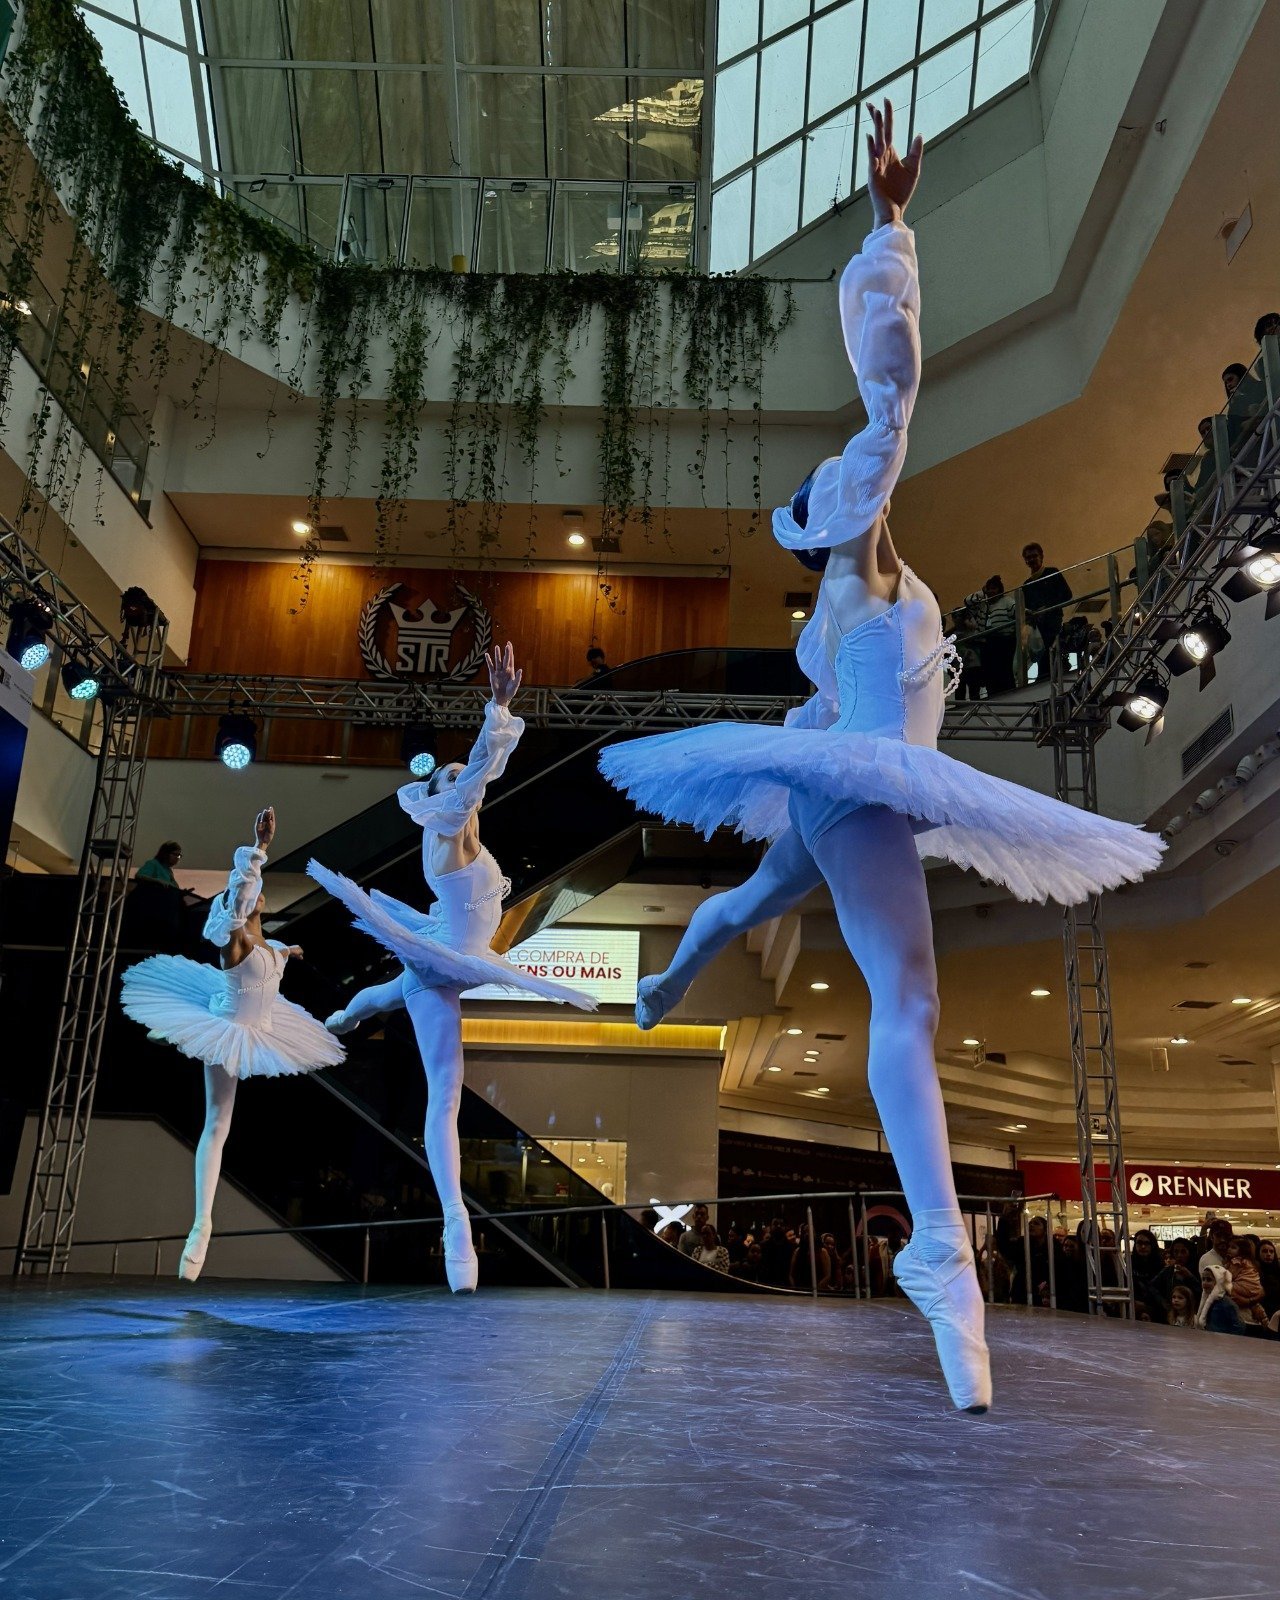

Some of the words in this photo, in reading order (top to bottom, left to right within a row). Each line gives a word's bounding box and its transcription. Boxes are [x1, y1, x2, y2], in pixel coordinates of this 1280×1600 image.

[396, 636, 451, 673] STR
[517, 949, 585, 963] COMPRA
[590, 951, 610, 965] DE
[552, 965, 576, 978] OU
[581, 966, 622, 979] MAIS
[1157, 1175, 1252, 1199] RENNER
